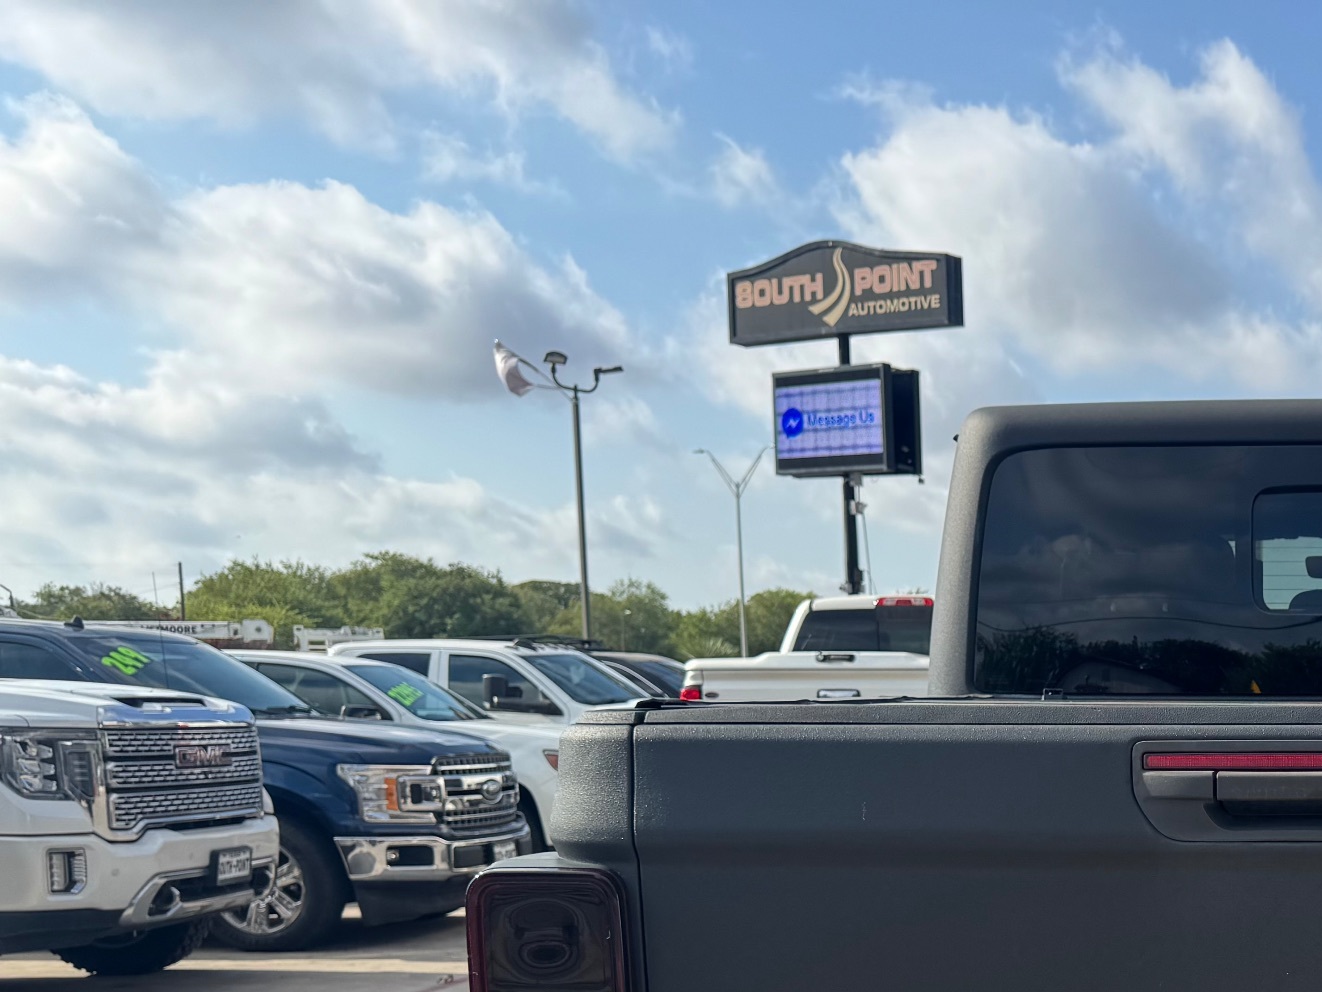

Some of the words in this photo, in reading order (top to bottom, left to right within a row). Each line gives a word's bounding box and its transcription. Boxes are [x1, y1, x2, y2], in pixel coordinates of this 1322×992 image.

[735, 273, 824, 309] SOUTH
[854, 259, 938, 296] POINT
[848, 294, 941, 317] AUTOMOTIVE
[807, 411, 857, 429] Message
[859, 408, 875, 424] Us
[175, 744, 233, 769] GMC
